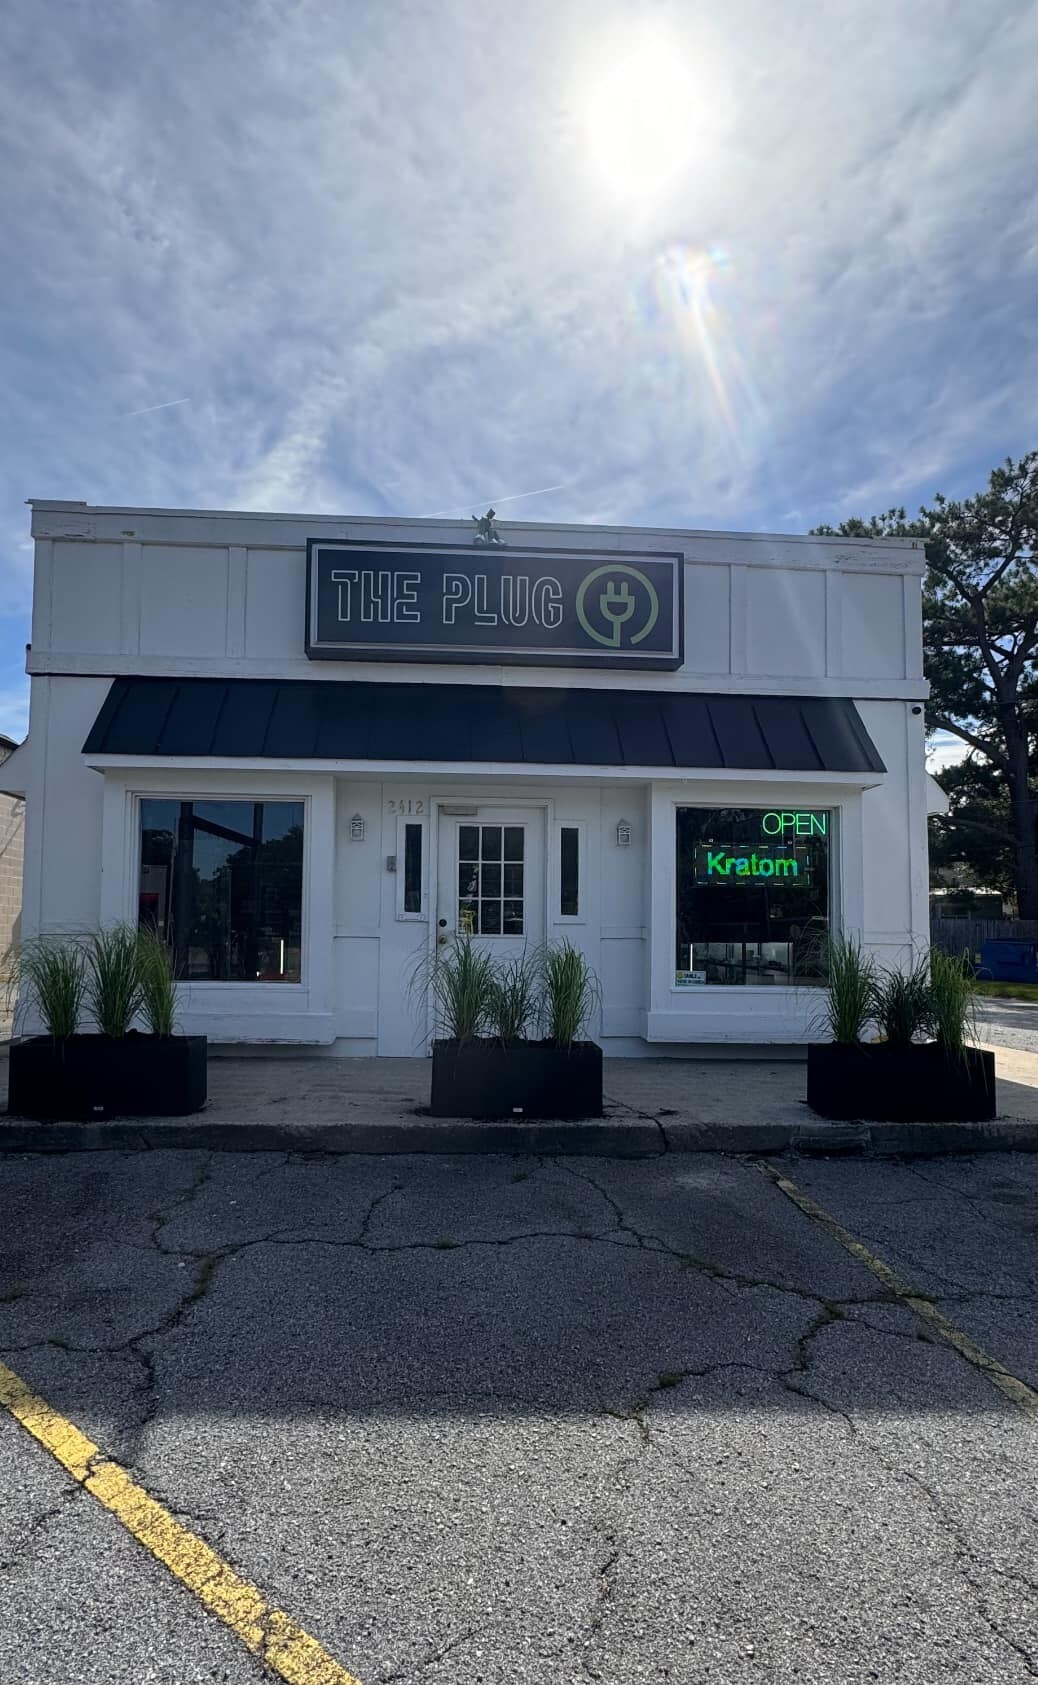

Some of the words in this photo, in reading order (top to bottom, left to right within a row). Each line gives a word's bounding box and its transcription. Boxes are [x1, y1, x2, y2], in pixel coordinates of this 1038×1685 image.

[331, 569, 421, 622] THE
[442, 573, 563, 628] PLUG
[762, 812, 827, 836] OPEN
[706, 851, 799, 877] Kratom
